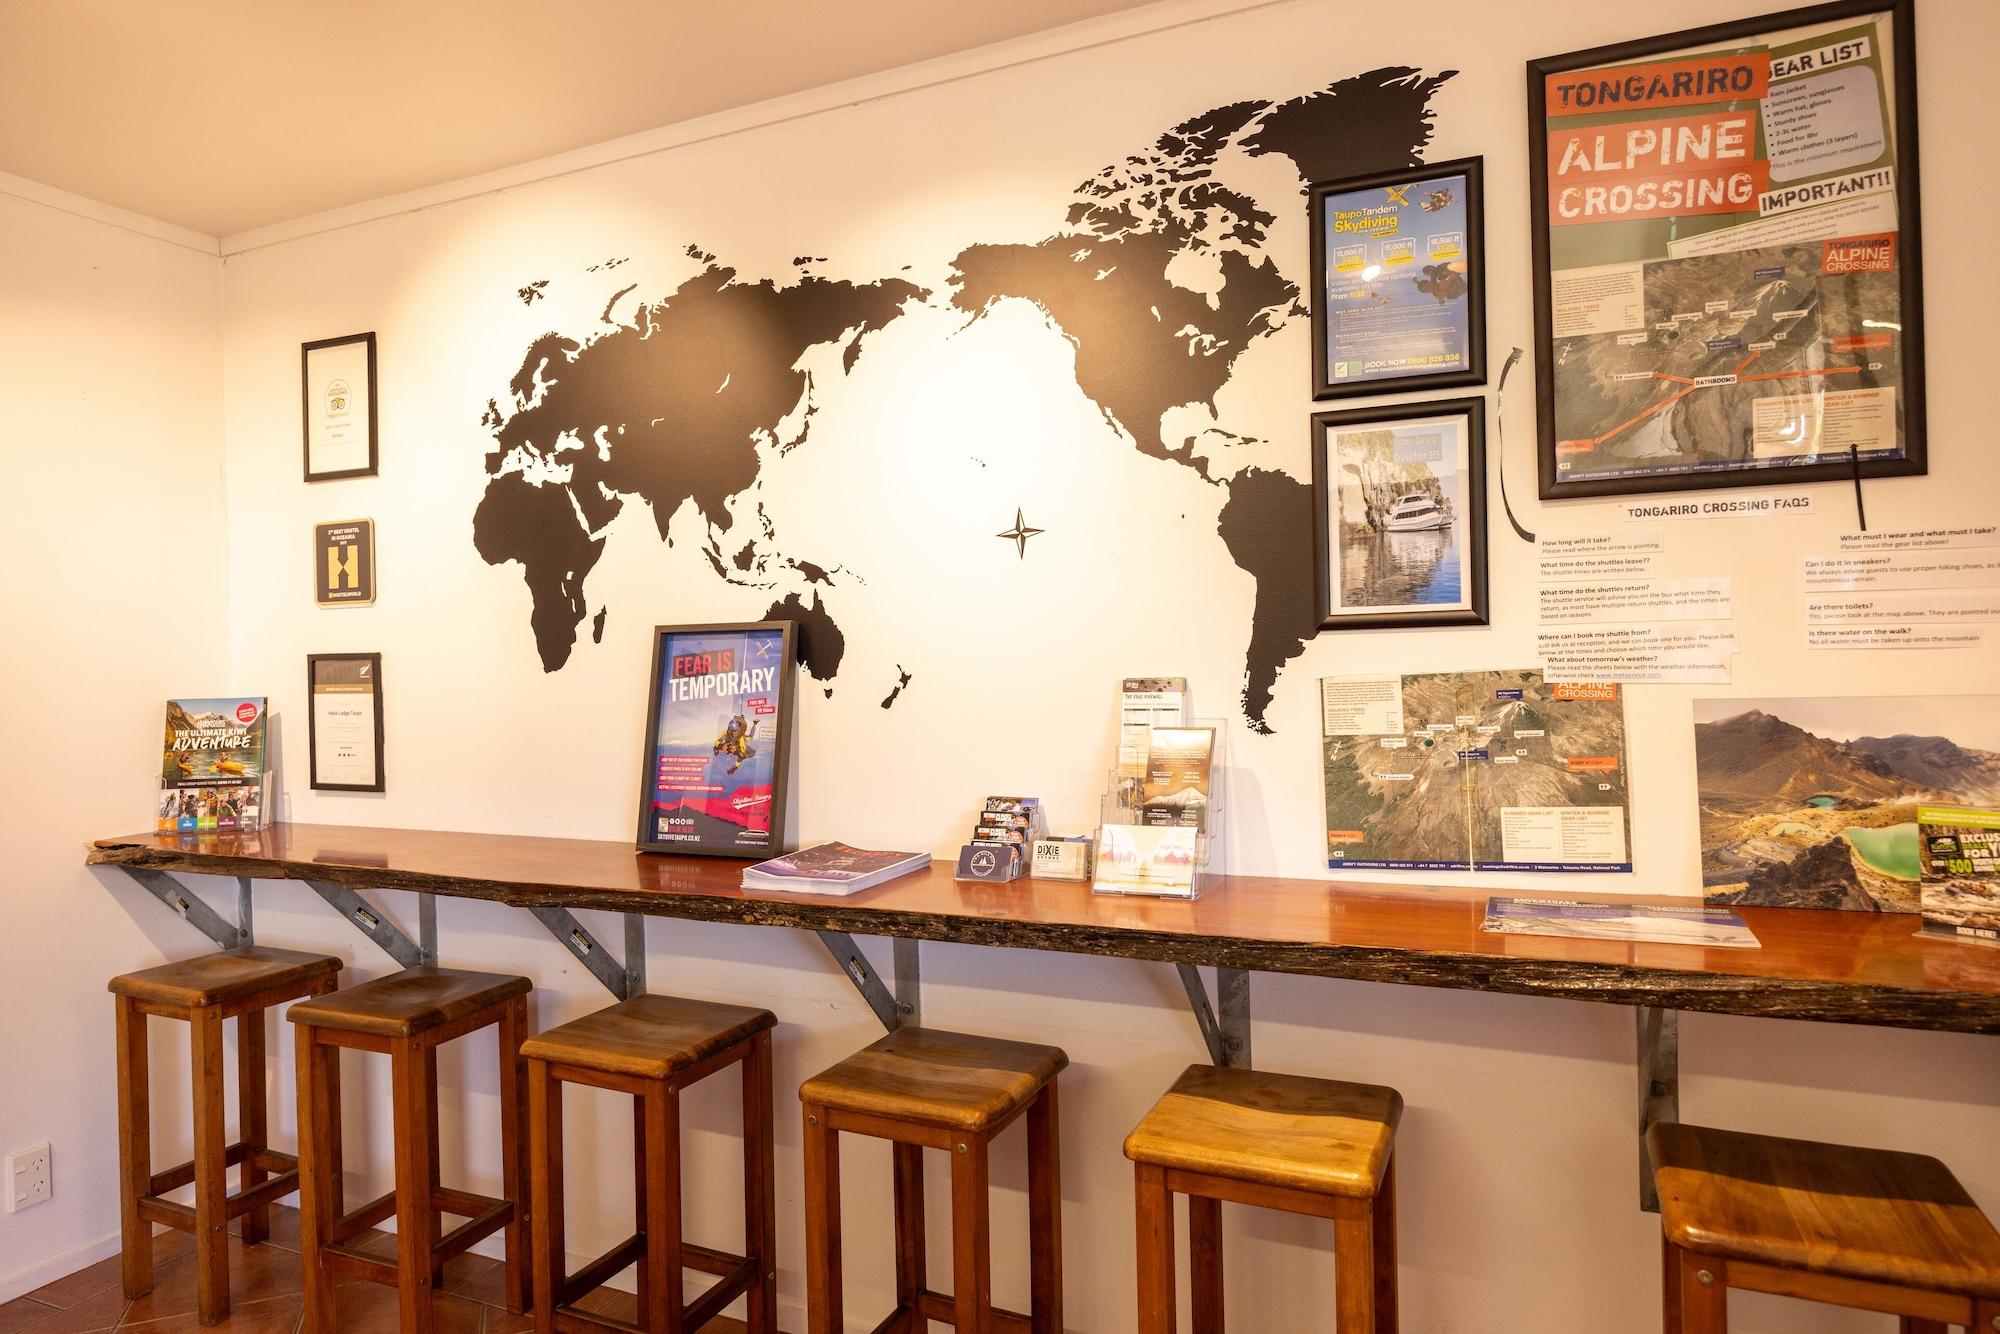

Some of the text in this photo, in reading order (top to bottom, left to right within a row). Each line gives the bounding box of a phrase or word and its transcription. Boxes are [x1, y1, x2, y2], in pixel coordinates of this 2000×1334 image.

[1820, 42, 1863, 66] LIST
[1557, 66, 1754, 108] TONGARIRO
[1557, 119, 1746, 176] ALPINE
[1558, 172, 1753, 218] CROSSING
[1762, 171, 1890, 212] IMPORTANT!!
[1334, 206, 1398, 220] Taupo Tandem
[1334, 215, 1398, 234] Skydiving
[1829, 239, 1890, 249] TONGARIRO
[1827, 247, 1890, 262] ALPINE
[1826, 260, 1890, 272] CROSSING
[1388, 358, 1406, 366] NOW
[1696, 376, 1735, 385] BATHROOMS
[1628, 497, 1809, 518] TONGARIRO CROSSING FAQS
[675, 651, 731, 676] FEAR IS
[670, 667, 775, 702] TEMPORARY
[1558, 689, 1613, 698] CROSSING
[190, 729, 226, 737] ULTIMATE
[228, 728, 247, 736] KIWI
[172, 736, 252, 752] ADVENTURE
[1963, 849, 1990, 858] FOR
[1956, 926, 1976, 936] BOOK
